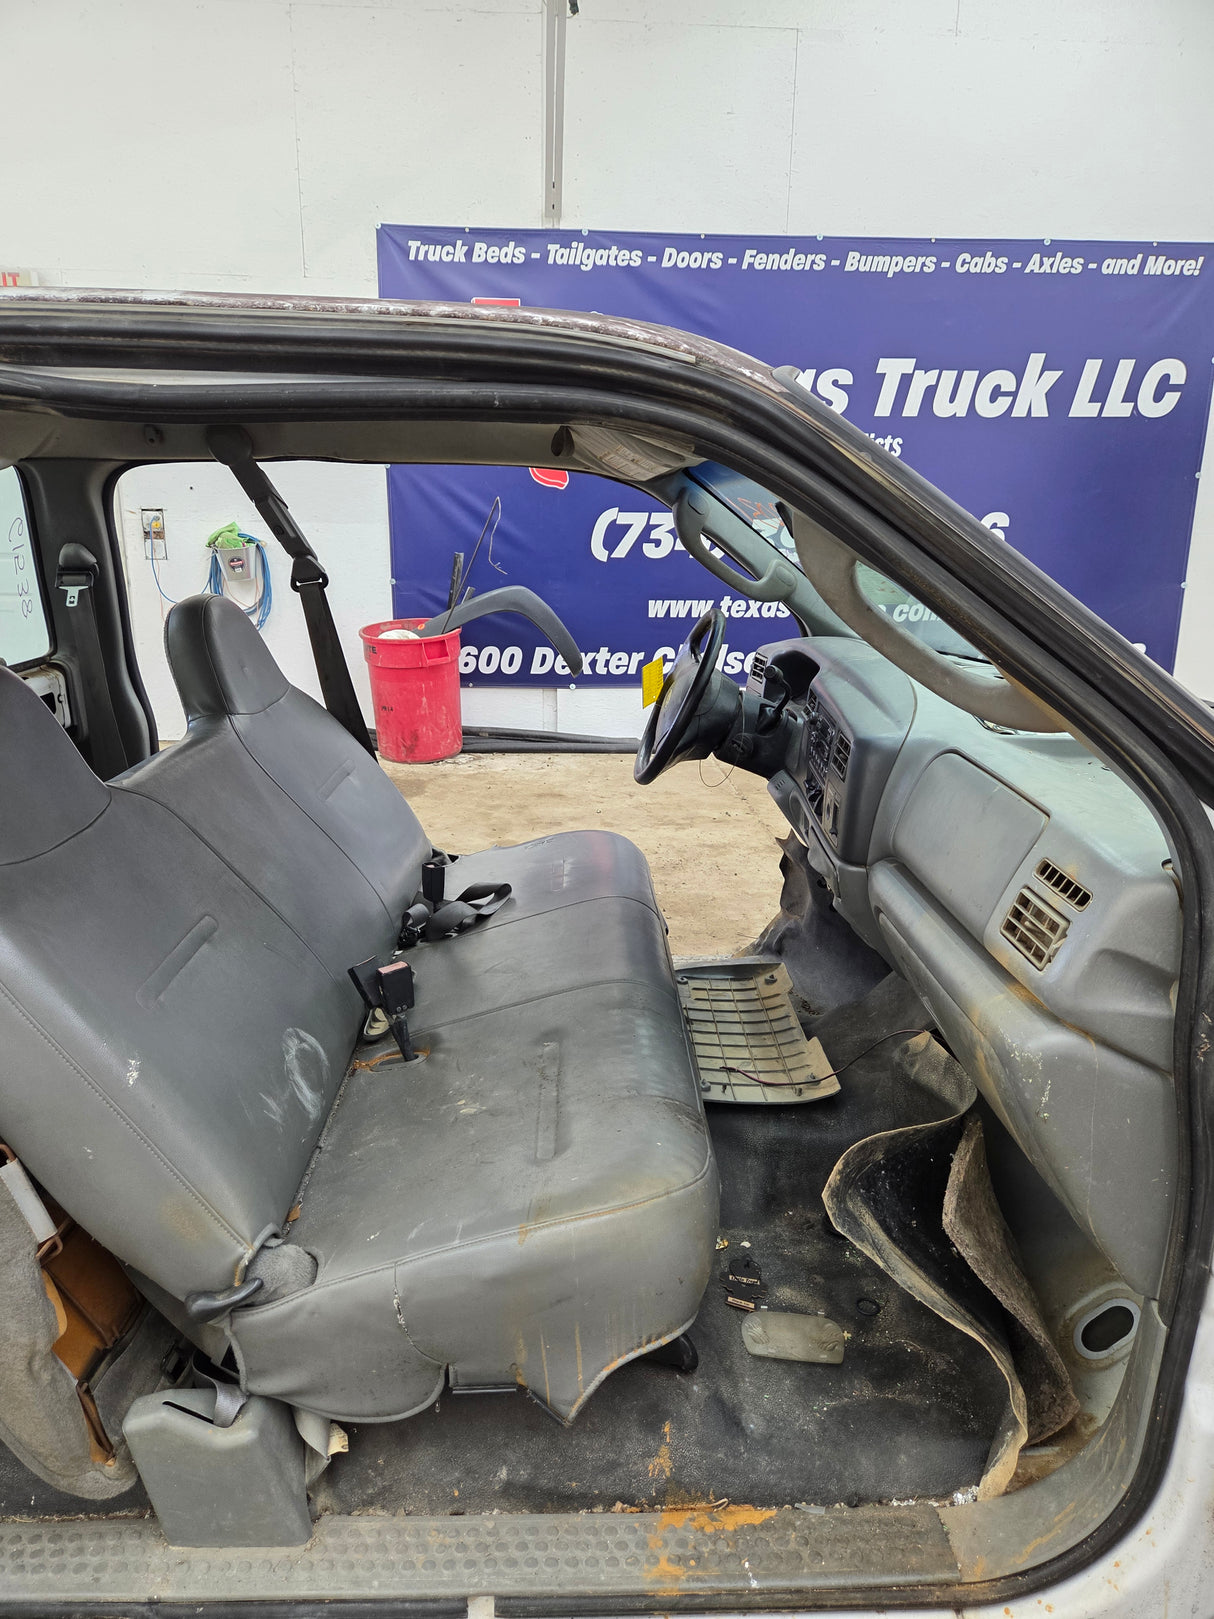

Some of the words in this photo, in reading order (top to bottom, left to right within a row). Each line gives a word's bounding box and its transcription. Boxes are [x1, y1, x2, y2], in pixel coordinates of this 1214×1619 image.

[407, 240, 467, 263] Truck
[471, 240, 526, 264] Beds
[546, 242, 642, 271] Tailgates
[660, 247, 723, 269] Doors
[742, 248, 826, 271] Fenders
[844, 251, 937, 278] Bumpers
[956, 252, 1008, 274] Cabs
[1024, 252, 1084, 275] Axles
[1101, 254, 1144, 276] and
[1143, 256, 1204, 277] More!
[873, 353, 1063, 418] Truck
[1068, 358, 1187, 419] LLC
[530, 640, 645, 676] Dexter
